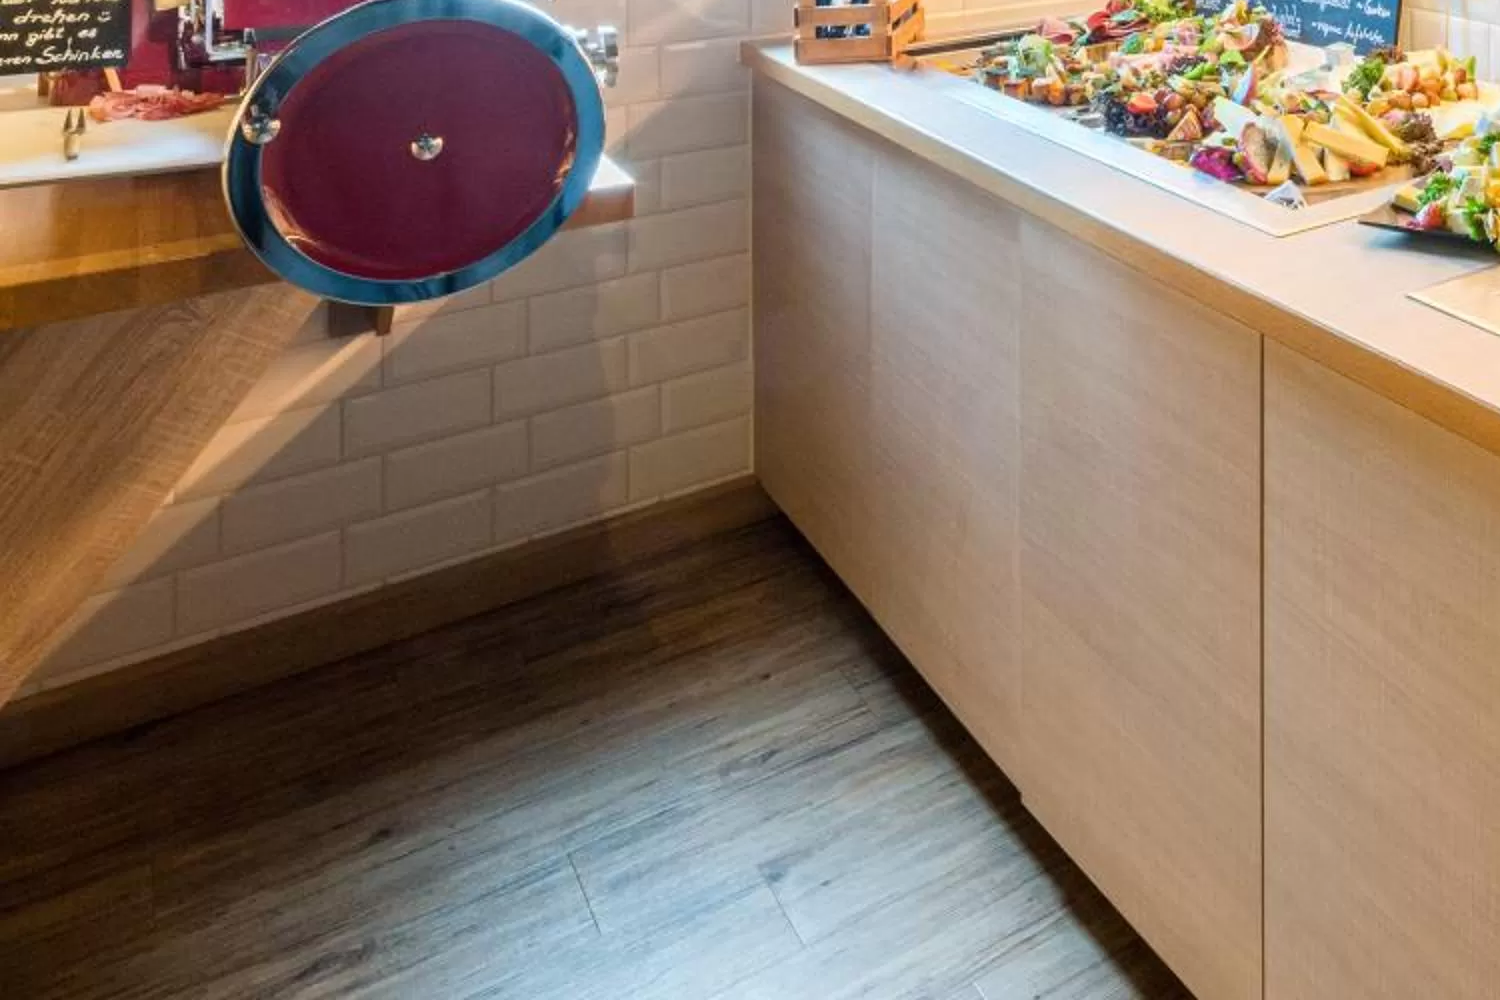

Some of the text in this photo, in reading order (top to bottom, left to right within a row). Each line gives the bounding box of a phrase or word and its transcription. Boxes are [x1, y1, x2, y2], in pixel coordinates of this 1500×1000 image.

[13, 9, 90, 25] drehen
[26, 27, 64, 47] gibt
[78, 28, 97, 38] es
[36, 38, 124, 64] Schinken
